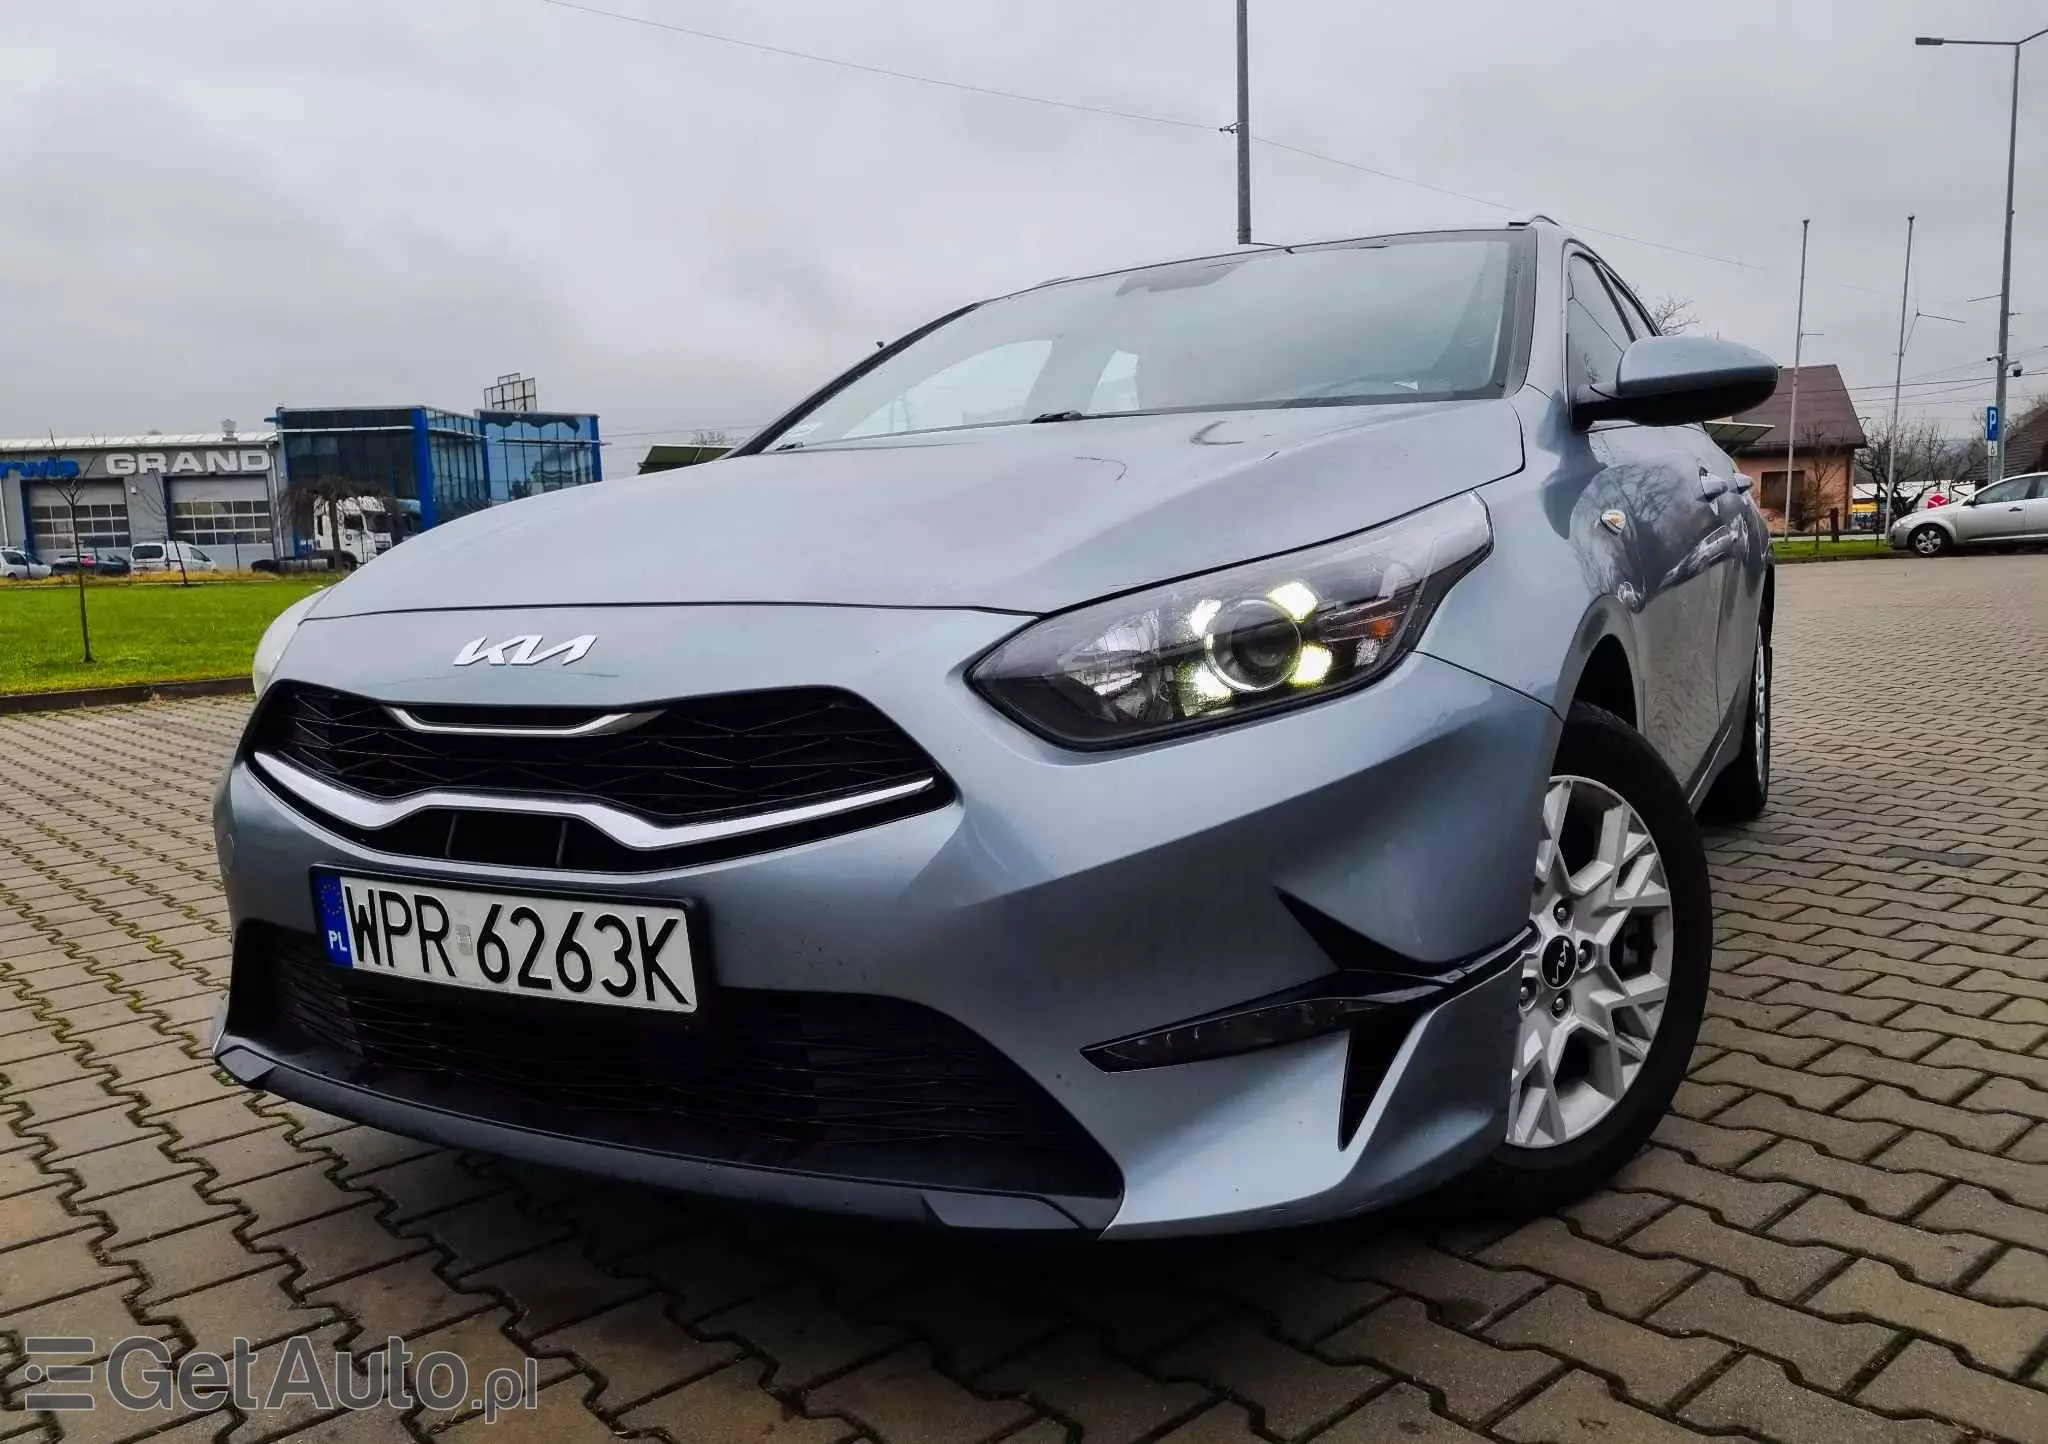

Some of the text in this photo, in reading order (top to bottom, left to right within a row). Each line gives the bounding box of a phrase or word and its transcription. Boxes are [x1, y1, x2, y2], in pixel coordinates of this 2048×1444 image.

[1989, 409, 1997, 431] P
[106, 450, 270, 475] GRAND
[453, 634, 598, 666] KIA
[328, 930, 347, 951] PL
[344, 885, 690, 1004] WPR 6263K
